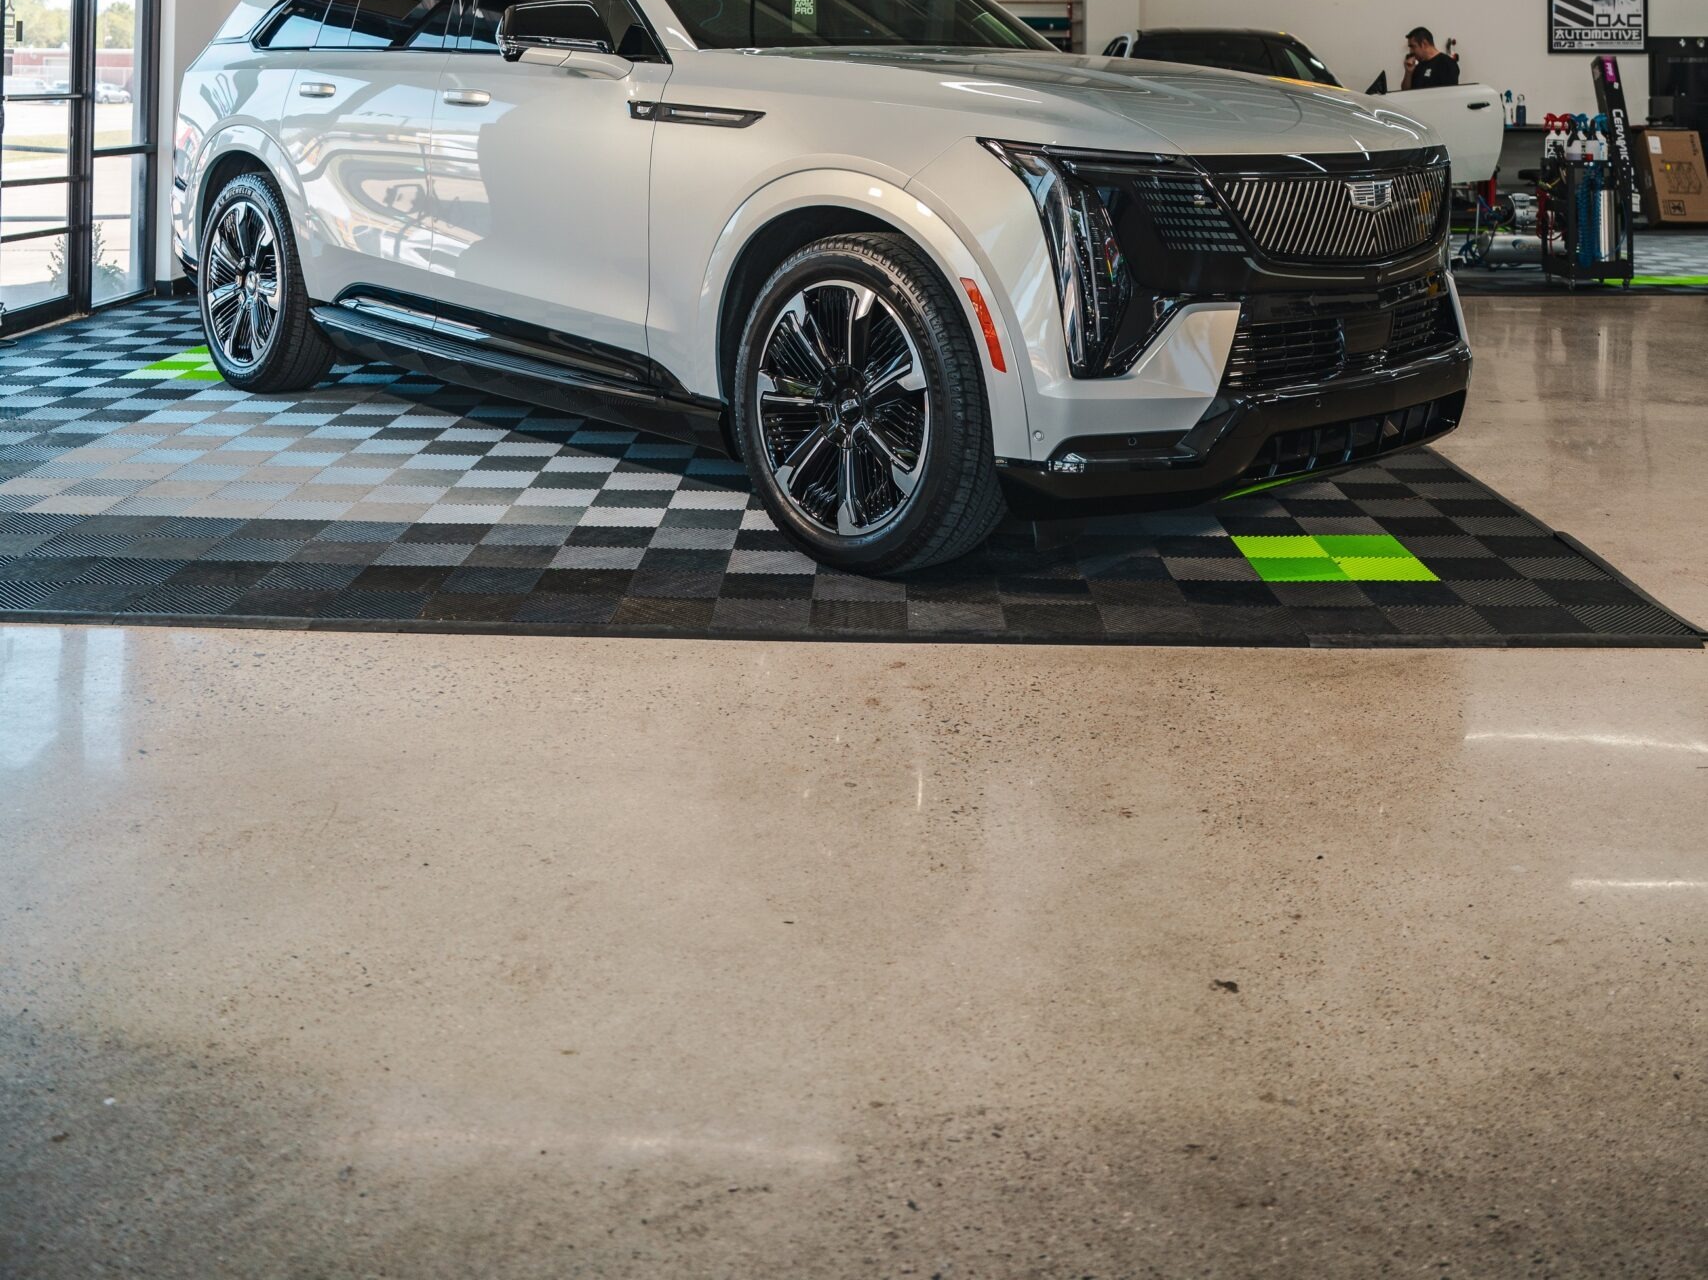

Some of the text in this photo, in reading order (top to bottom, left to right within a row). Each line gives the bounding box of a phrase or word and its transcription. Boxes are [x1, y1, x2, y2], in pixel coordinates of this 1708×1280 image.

[795, 7, 814, 15] PRO
[1555, 29, 1641, 40] AUTOMOTIVE
[1612, 109, 1630, 161] CERAMIC
